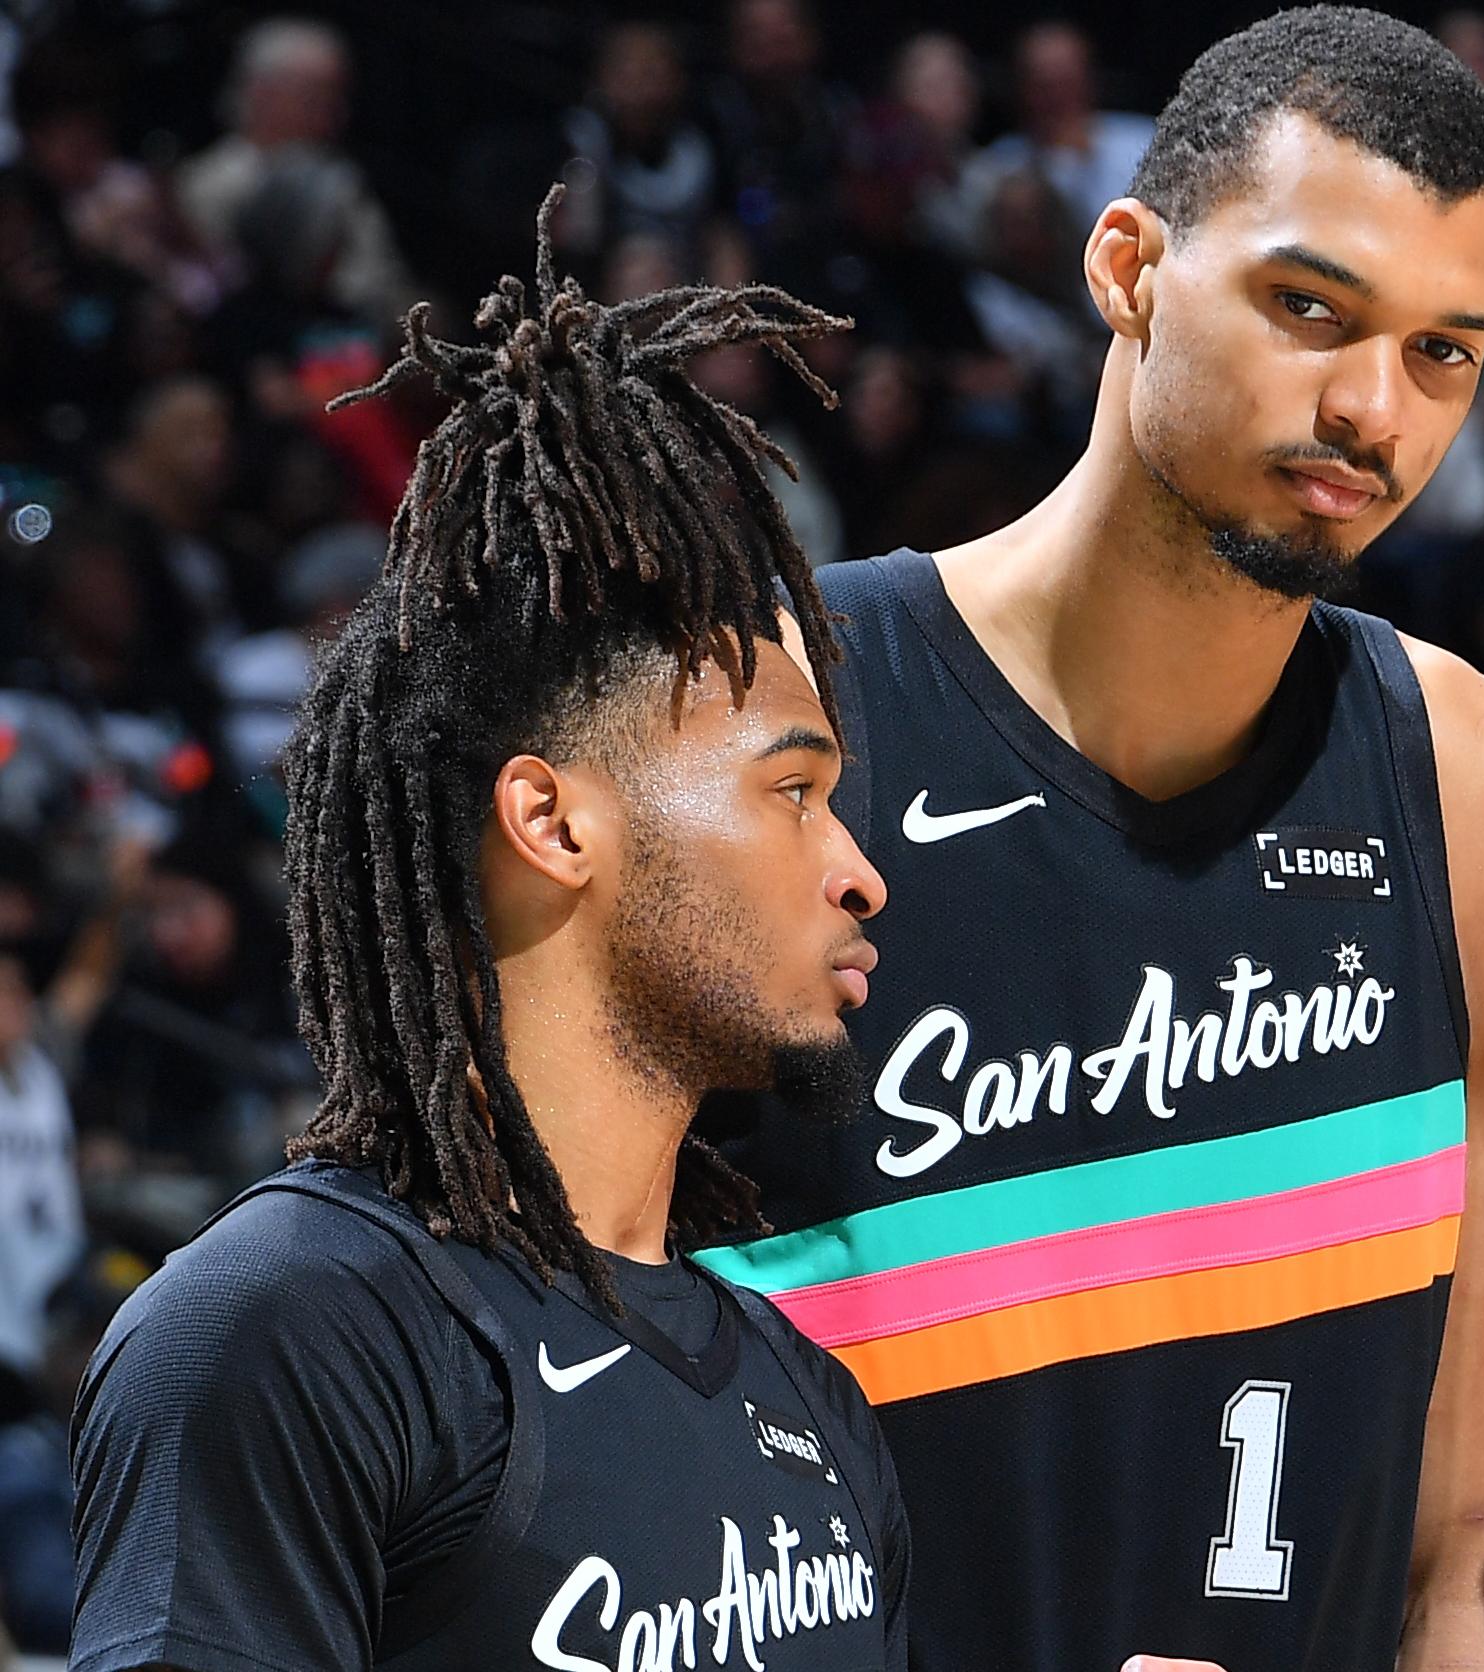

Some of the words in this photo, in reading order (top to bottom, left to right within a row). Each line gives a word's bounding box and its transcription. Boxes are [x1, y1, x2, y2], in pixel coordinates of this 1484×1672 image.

[1277, 847, 1375, 880] LEDGER
[872, 1007, 1072, 1179] San
[1080, 941, 1396, 1120] Antonio
[758, 1420, 823, 1466] LEDGER
[1204, 1379, 1295, 1602] 1
[530, 1554, 697, 1672] San
[701, 1514, 875, 1672] Antonio
